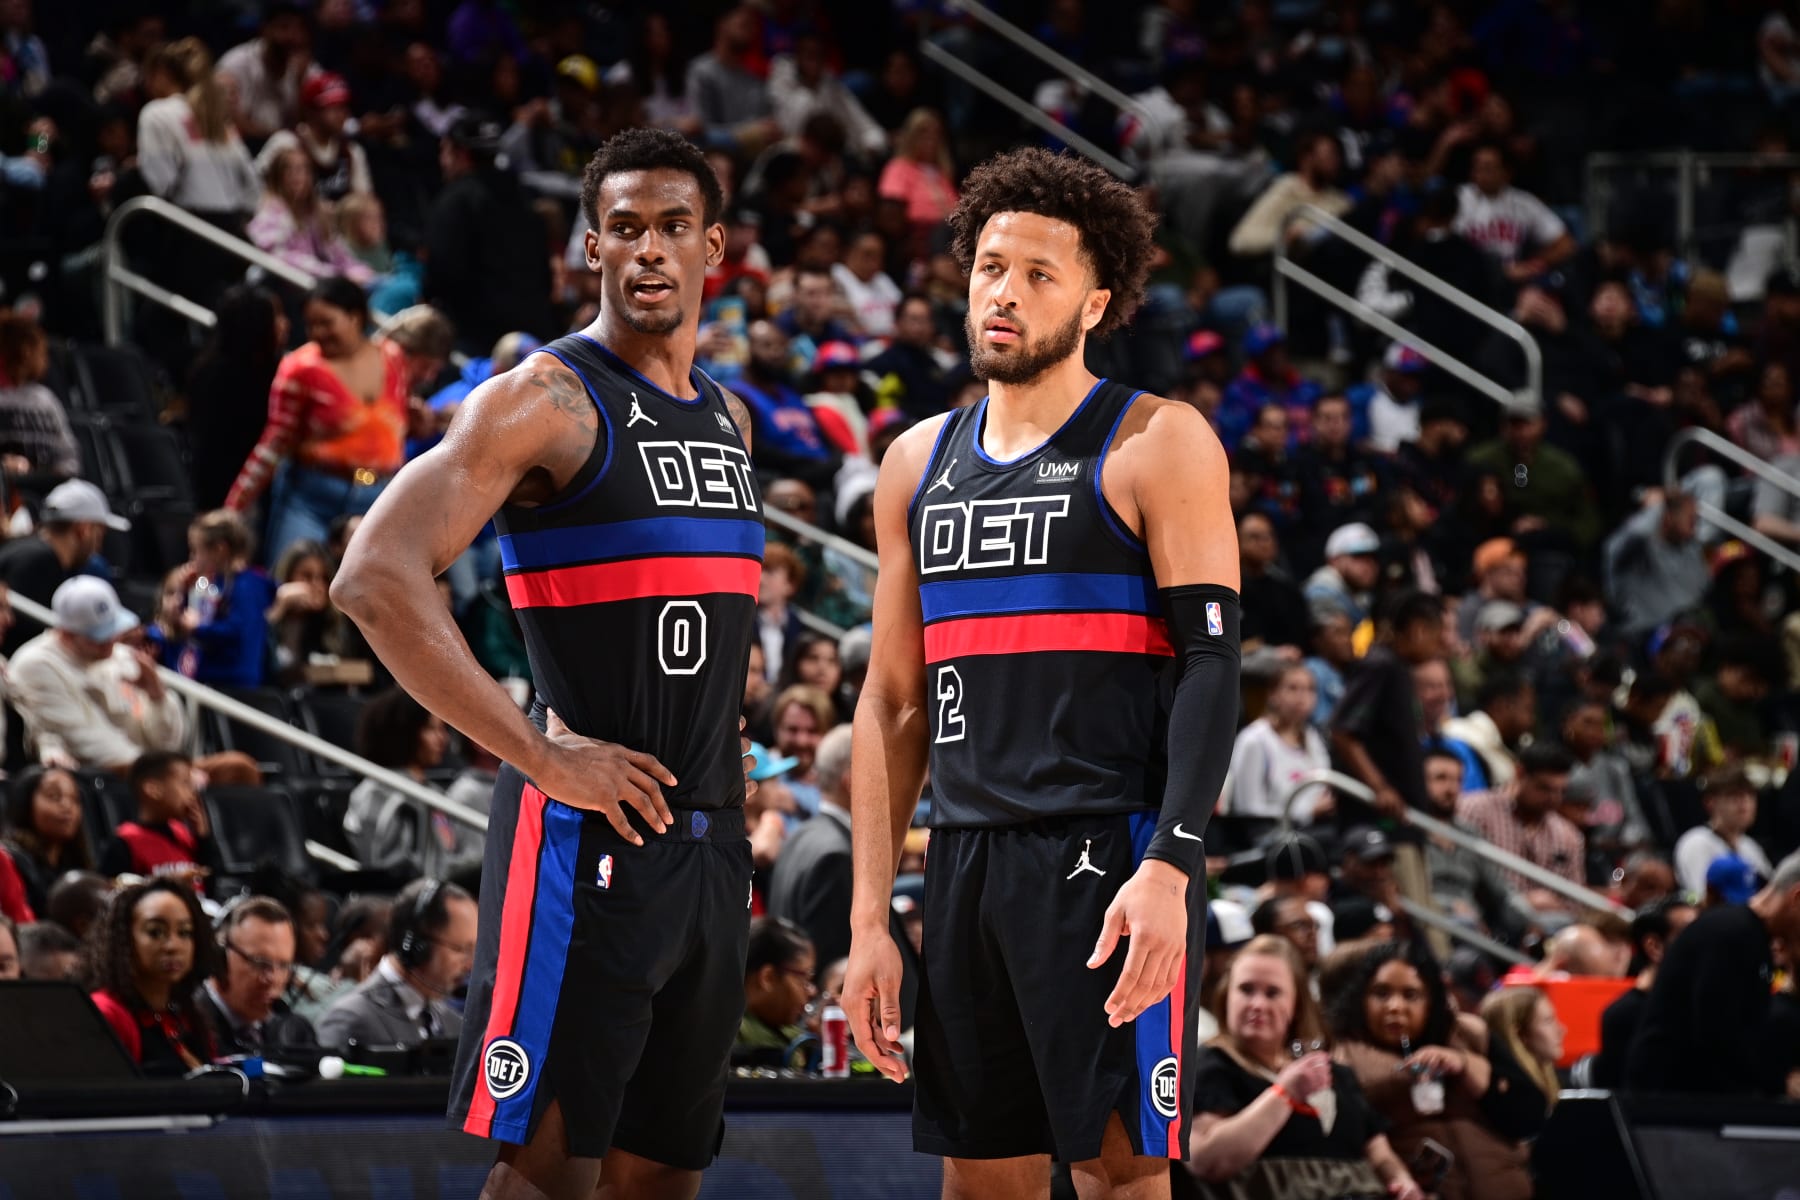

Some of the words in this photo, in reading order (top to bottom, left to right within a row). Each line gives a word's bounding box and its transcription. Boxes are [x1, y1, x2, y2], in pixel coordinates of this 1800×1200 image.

[637, 440, 758, 512] DET
[1038, 462, 1080, 478] UWM
[920, 494, 1071, 575] DET
[658, 600, 707, 675] 0
[934, 665, 966, 744] 2
[489, 1056, 521, 1083] DET
[1157, 1075, 1176, 1098] DE
